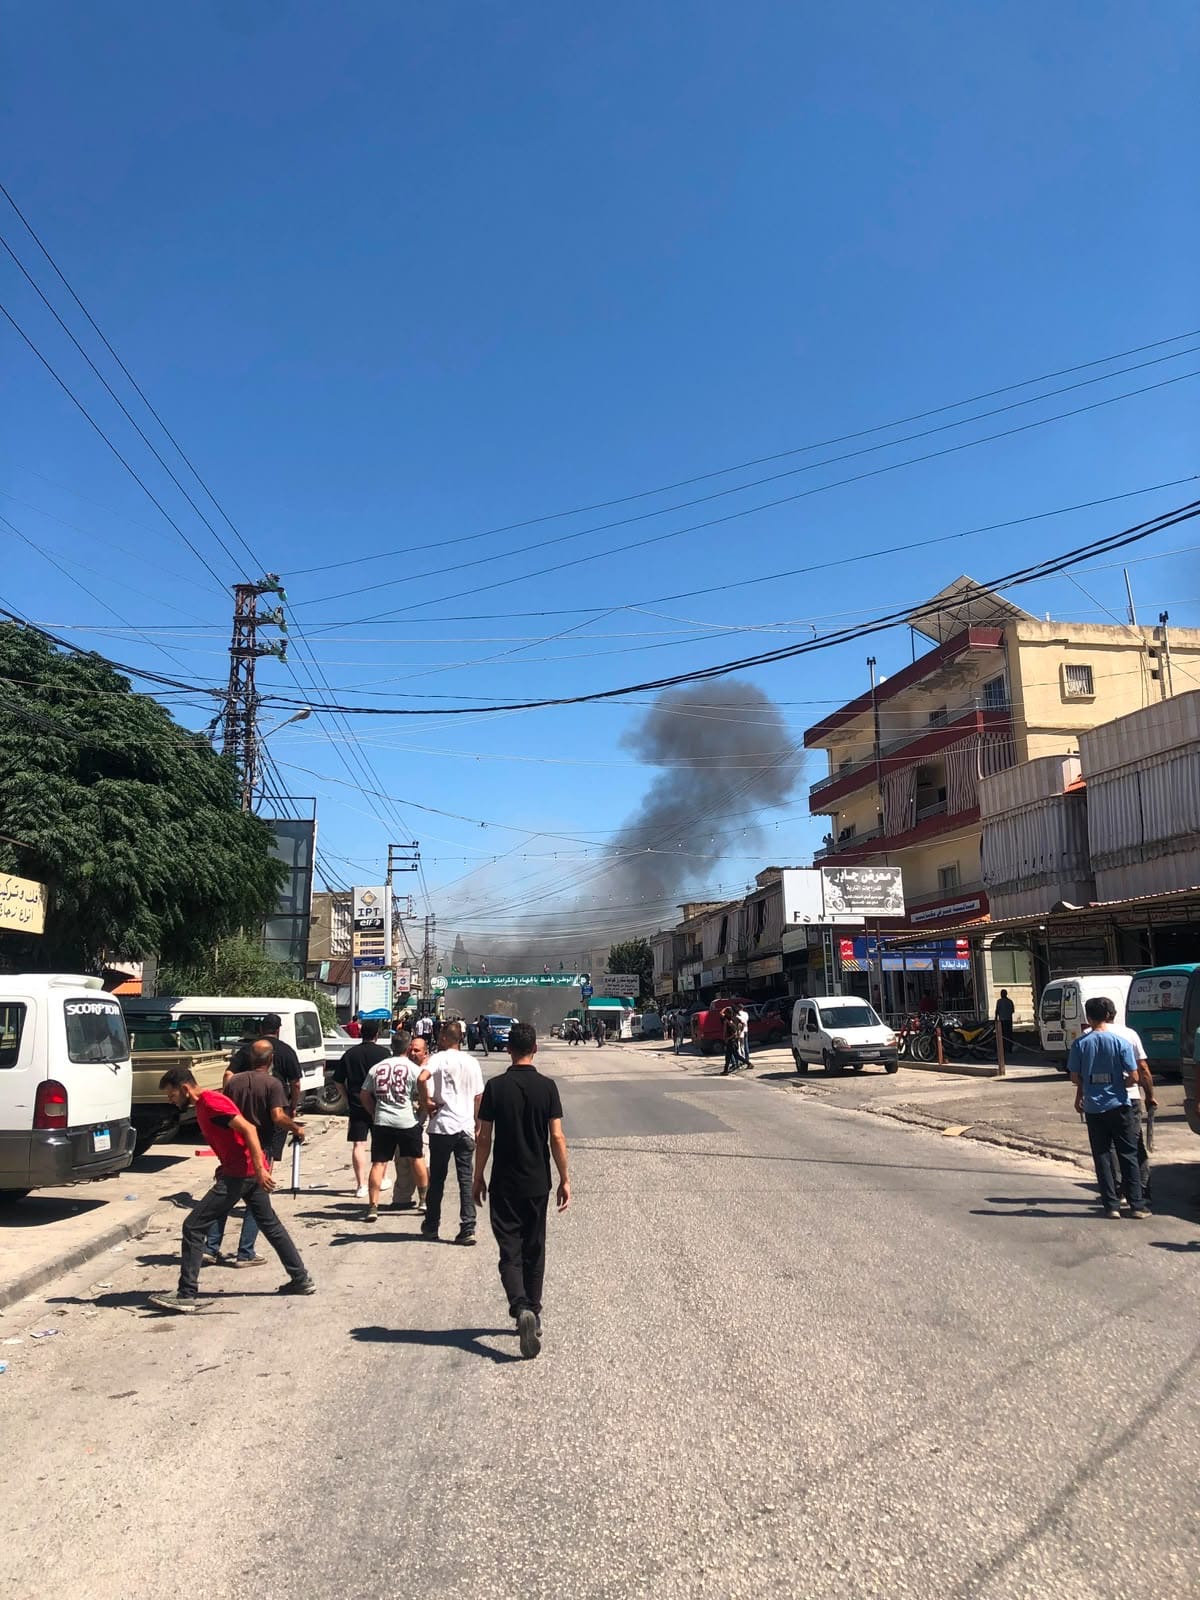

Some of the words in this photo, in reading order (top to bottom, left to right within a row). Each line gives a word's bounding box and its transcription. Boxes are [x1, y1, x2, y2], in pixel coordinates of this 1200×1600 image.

[834, 868, 859, 882] جابر
[861, 869, 892, 883] معرض
[0, 878, 25, 902] وتركي
[357, 907, 380, 918] IPT
